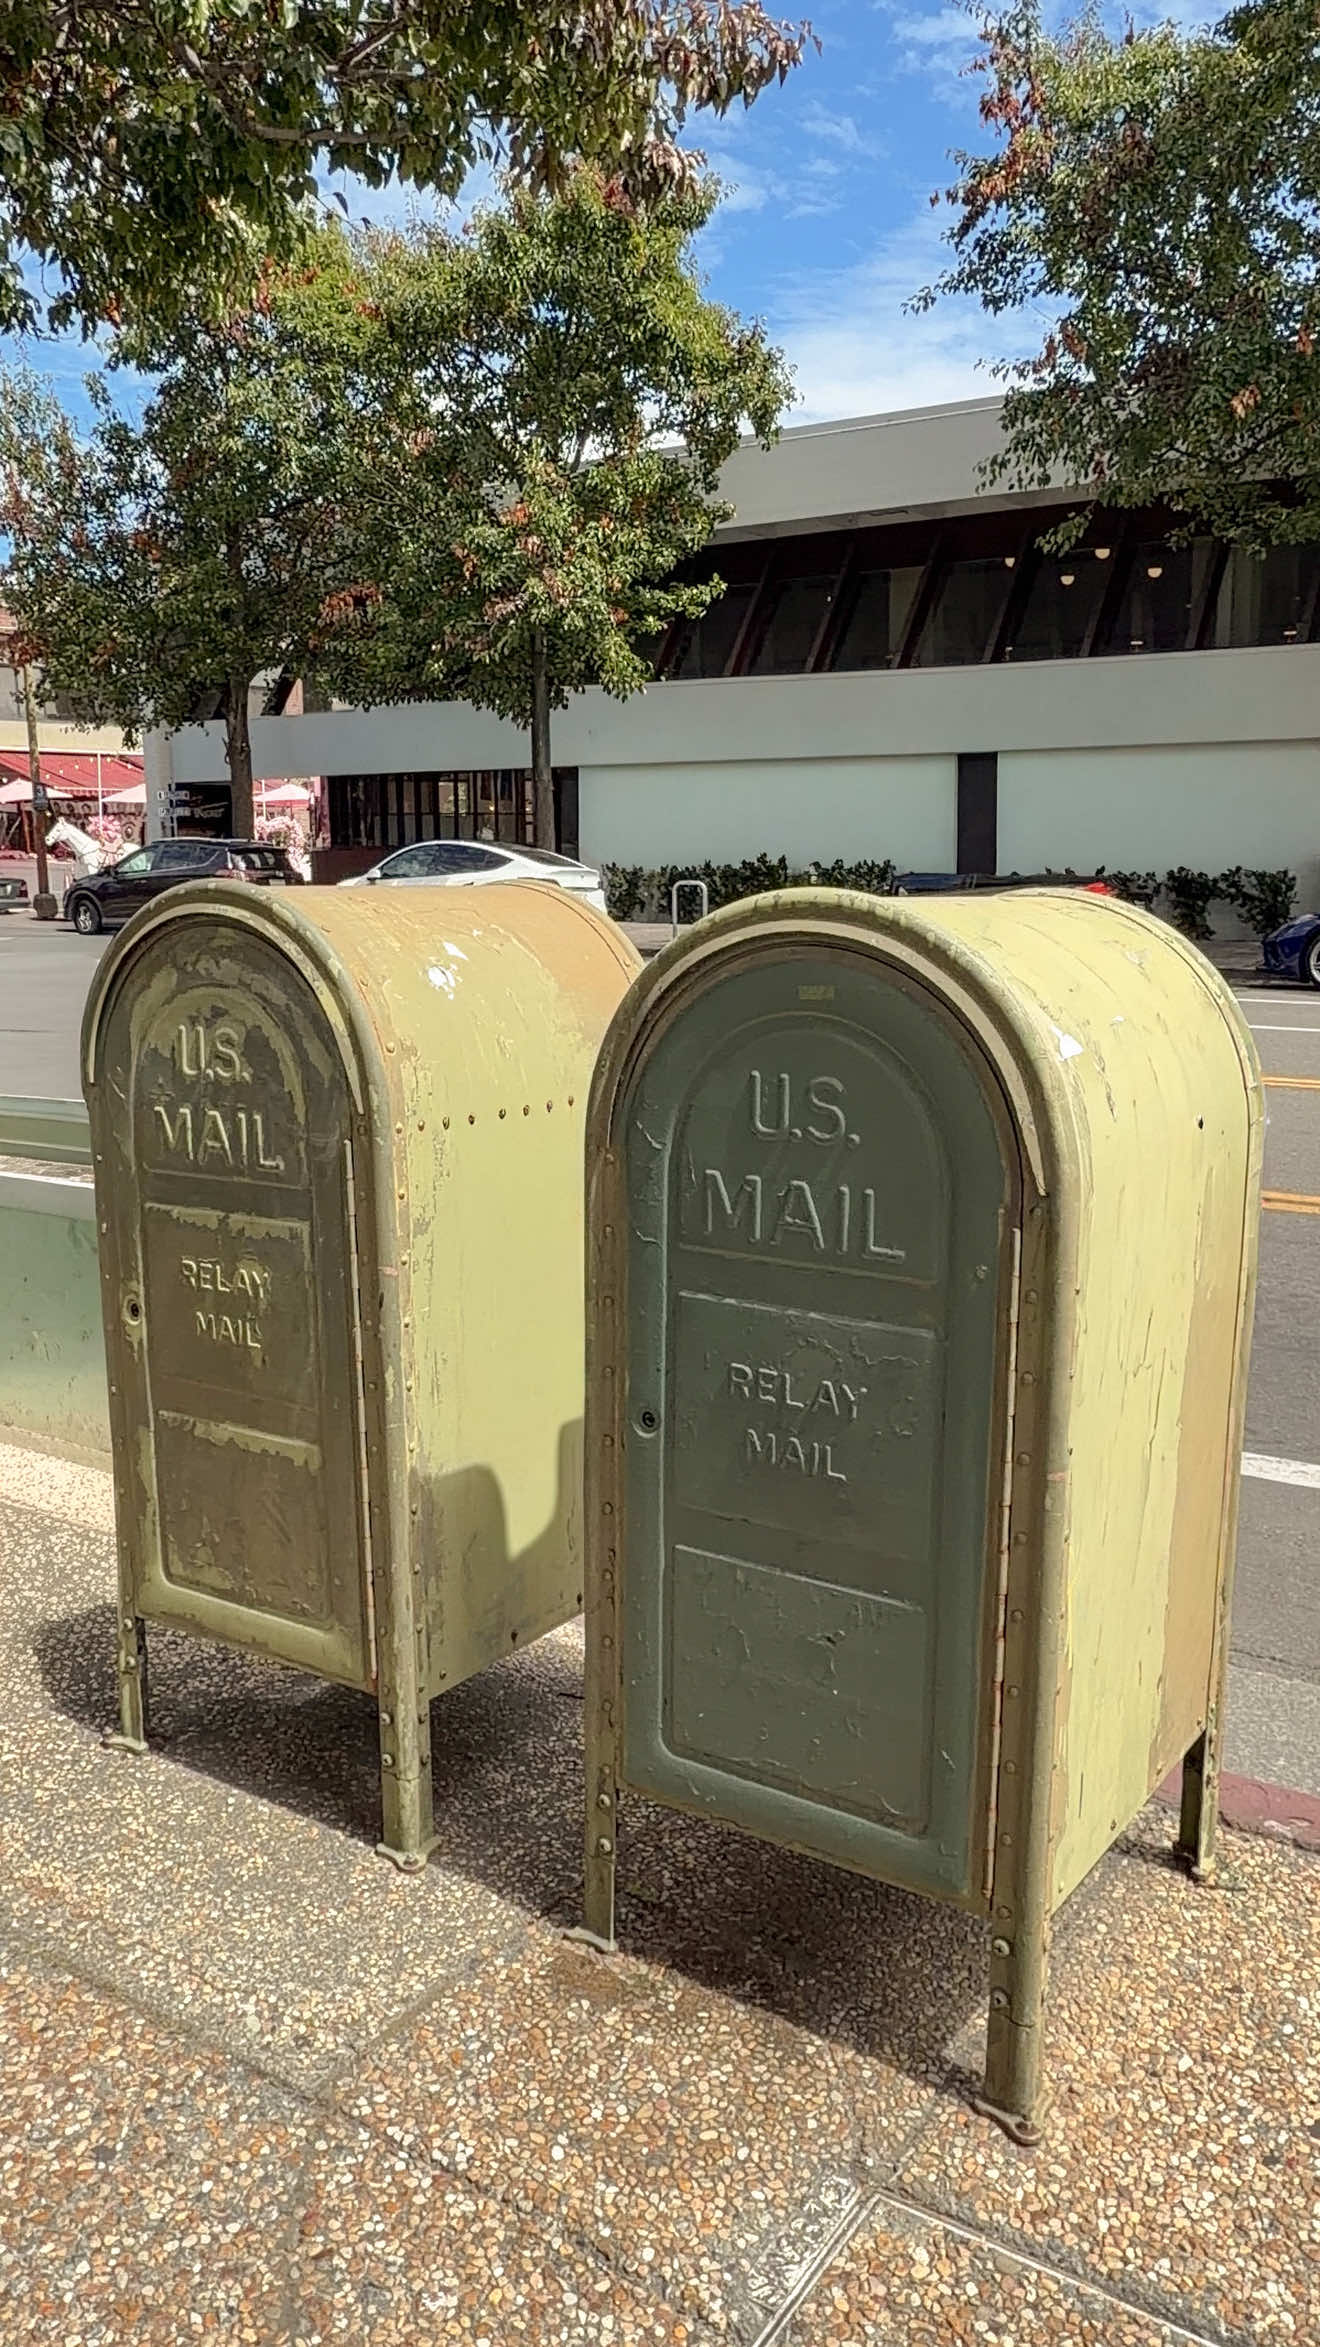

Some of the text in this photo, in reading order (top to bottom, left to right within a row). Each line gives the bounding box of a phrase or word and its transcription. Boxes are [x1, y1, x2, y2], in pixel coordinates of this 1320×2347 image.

[178, 1023, 252, 1085] U.S.
[153, 1105, 285, 1172] MAIL
[749, 1068, 862, 1149] U.S.
[703, 1168, 906, 1263] MAIL
[180, 1258, 272, 1299] RELAY
[195, 1311, 263, 1348] MAIL
[726, 1361, 868, 1420] RELAY
[743, 1428, 849, 1482] MAIL
